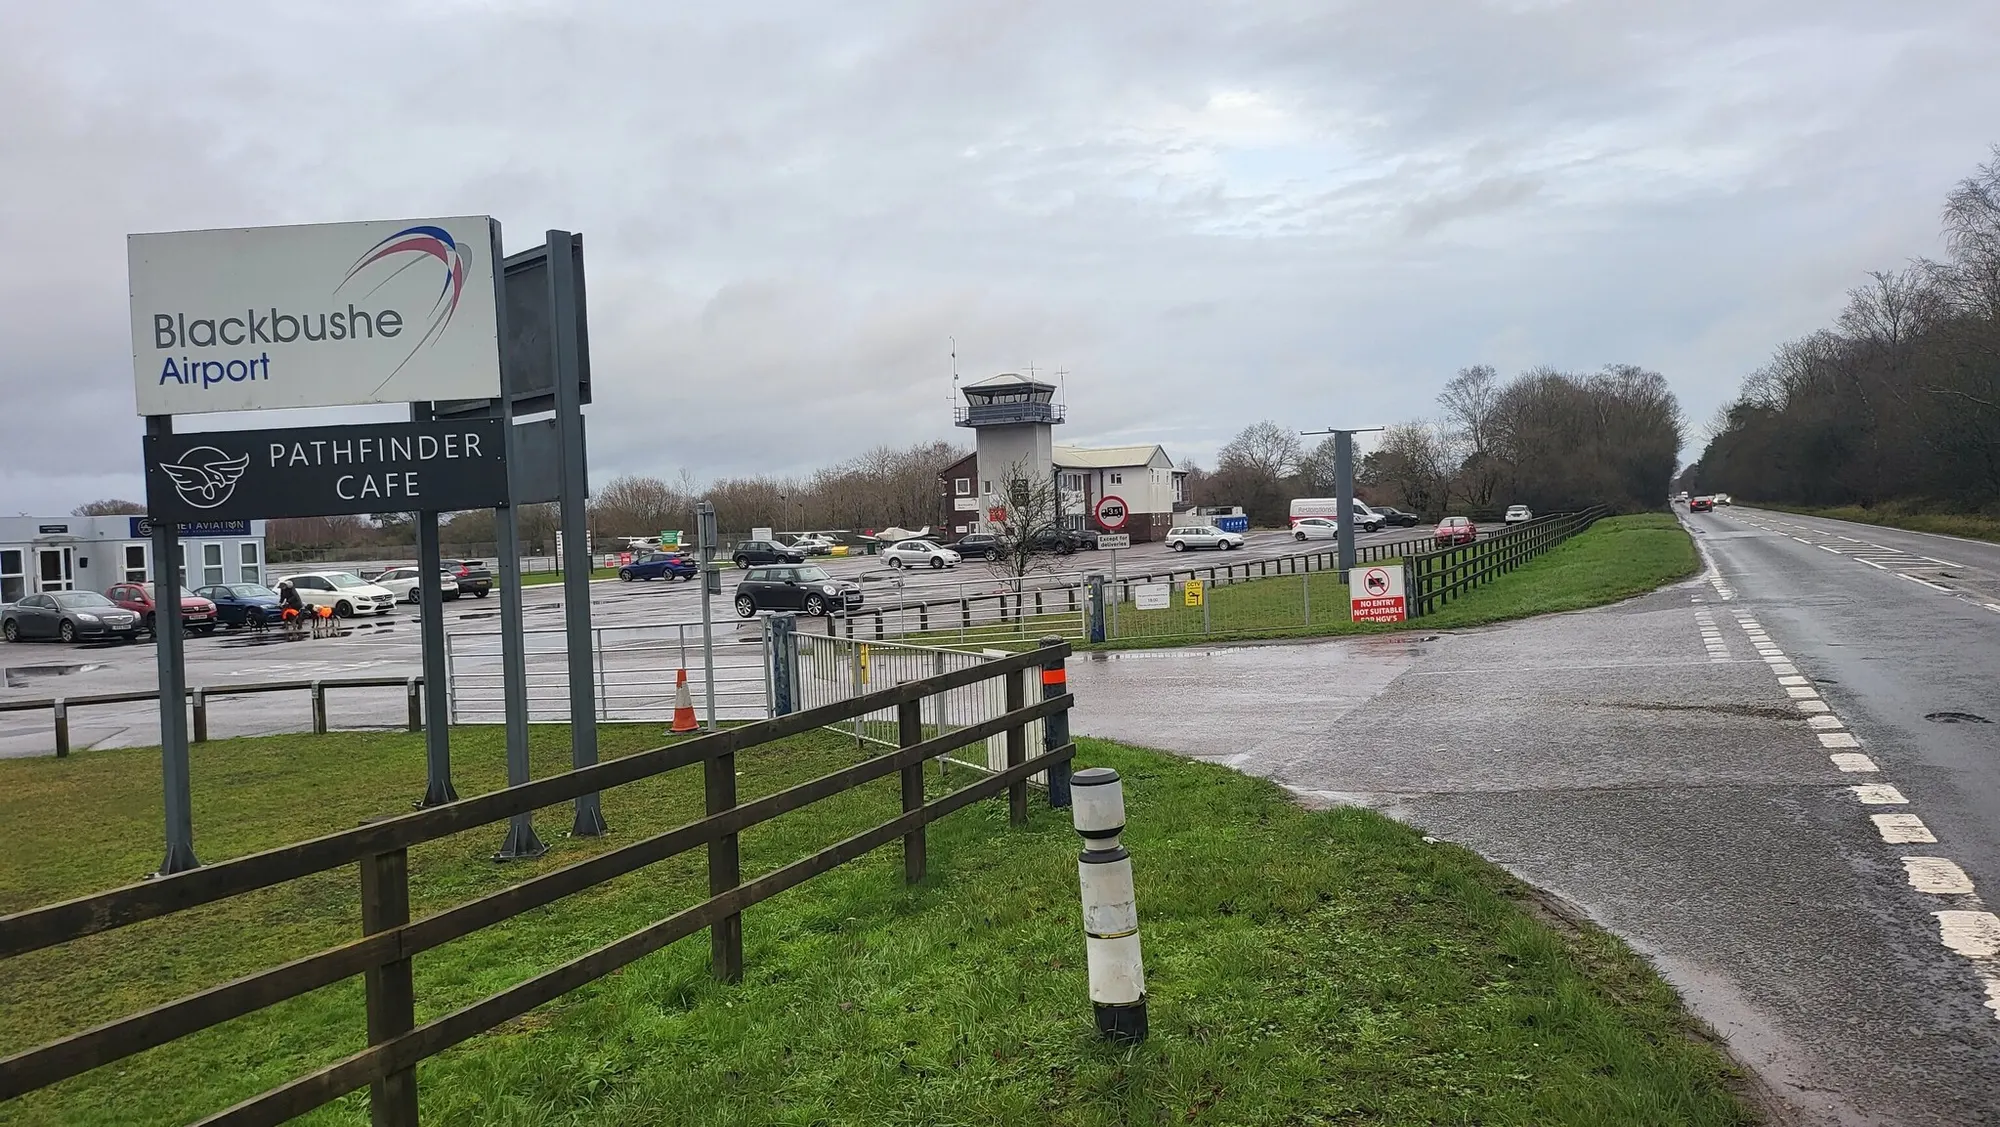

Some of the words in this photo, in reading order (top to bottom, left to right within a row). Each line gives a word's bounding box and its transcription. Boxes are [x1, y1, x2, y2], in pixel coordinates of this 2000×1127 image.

[154, 303, 403, 349] Blackbushe
[159, 352, 271, 389] Airport
[269, 433, 483, 468] PATHFINDER
[336, 472, 420, 500] CAFE
[1354, 608, 1369, 616] NOT
[1370, 606, 1403, 615] SUITABLE
[1372, 599, 1395, 607] ENTRY
[1376, 615, 1398, 623] HGV'S
